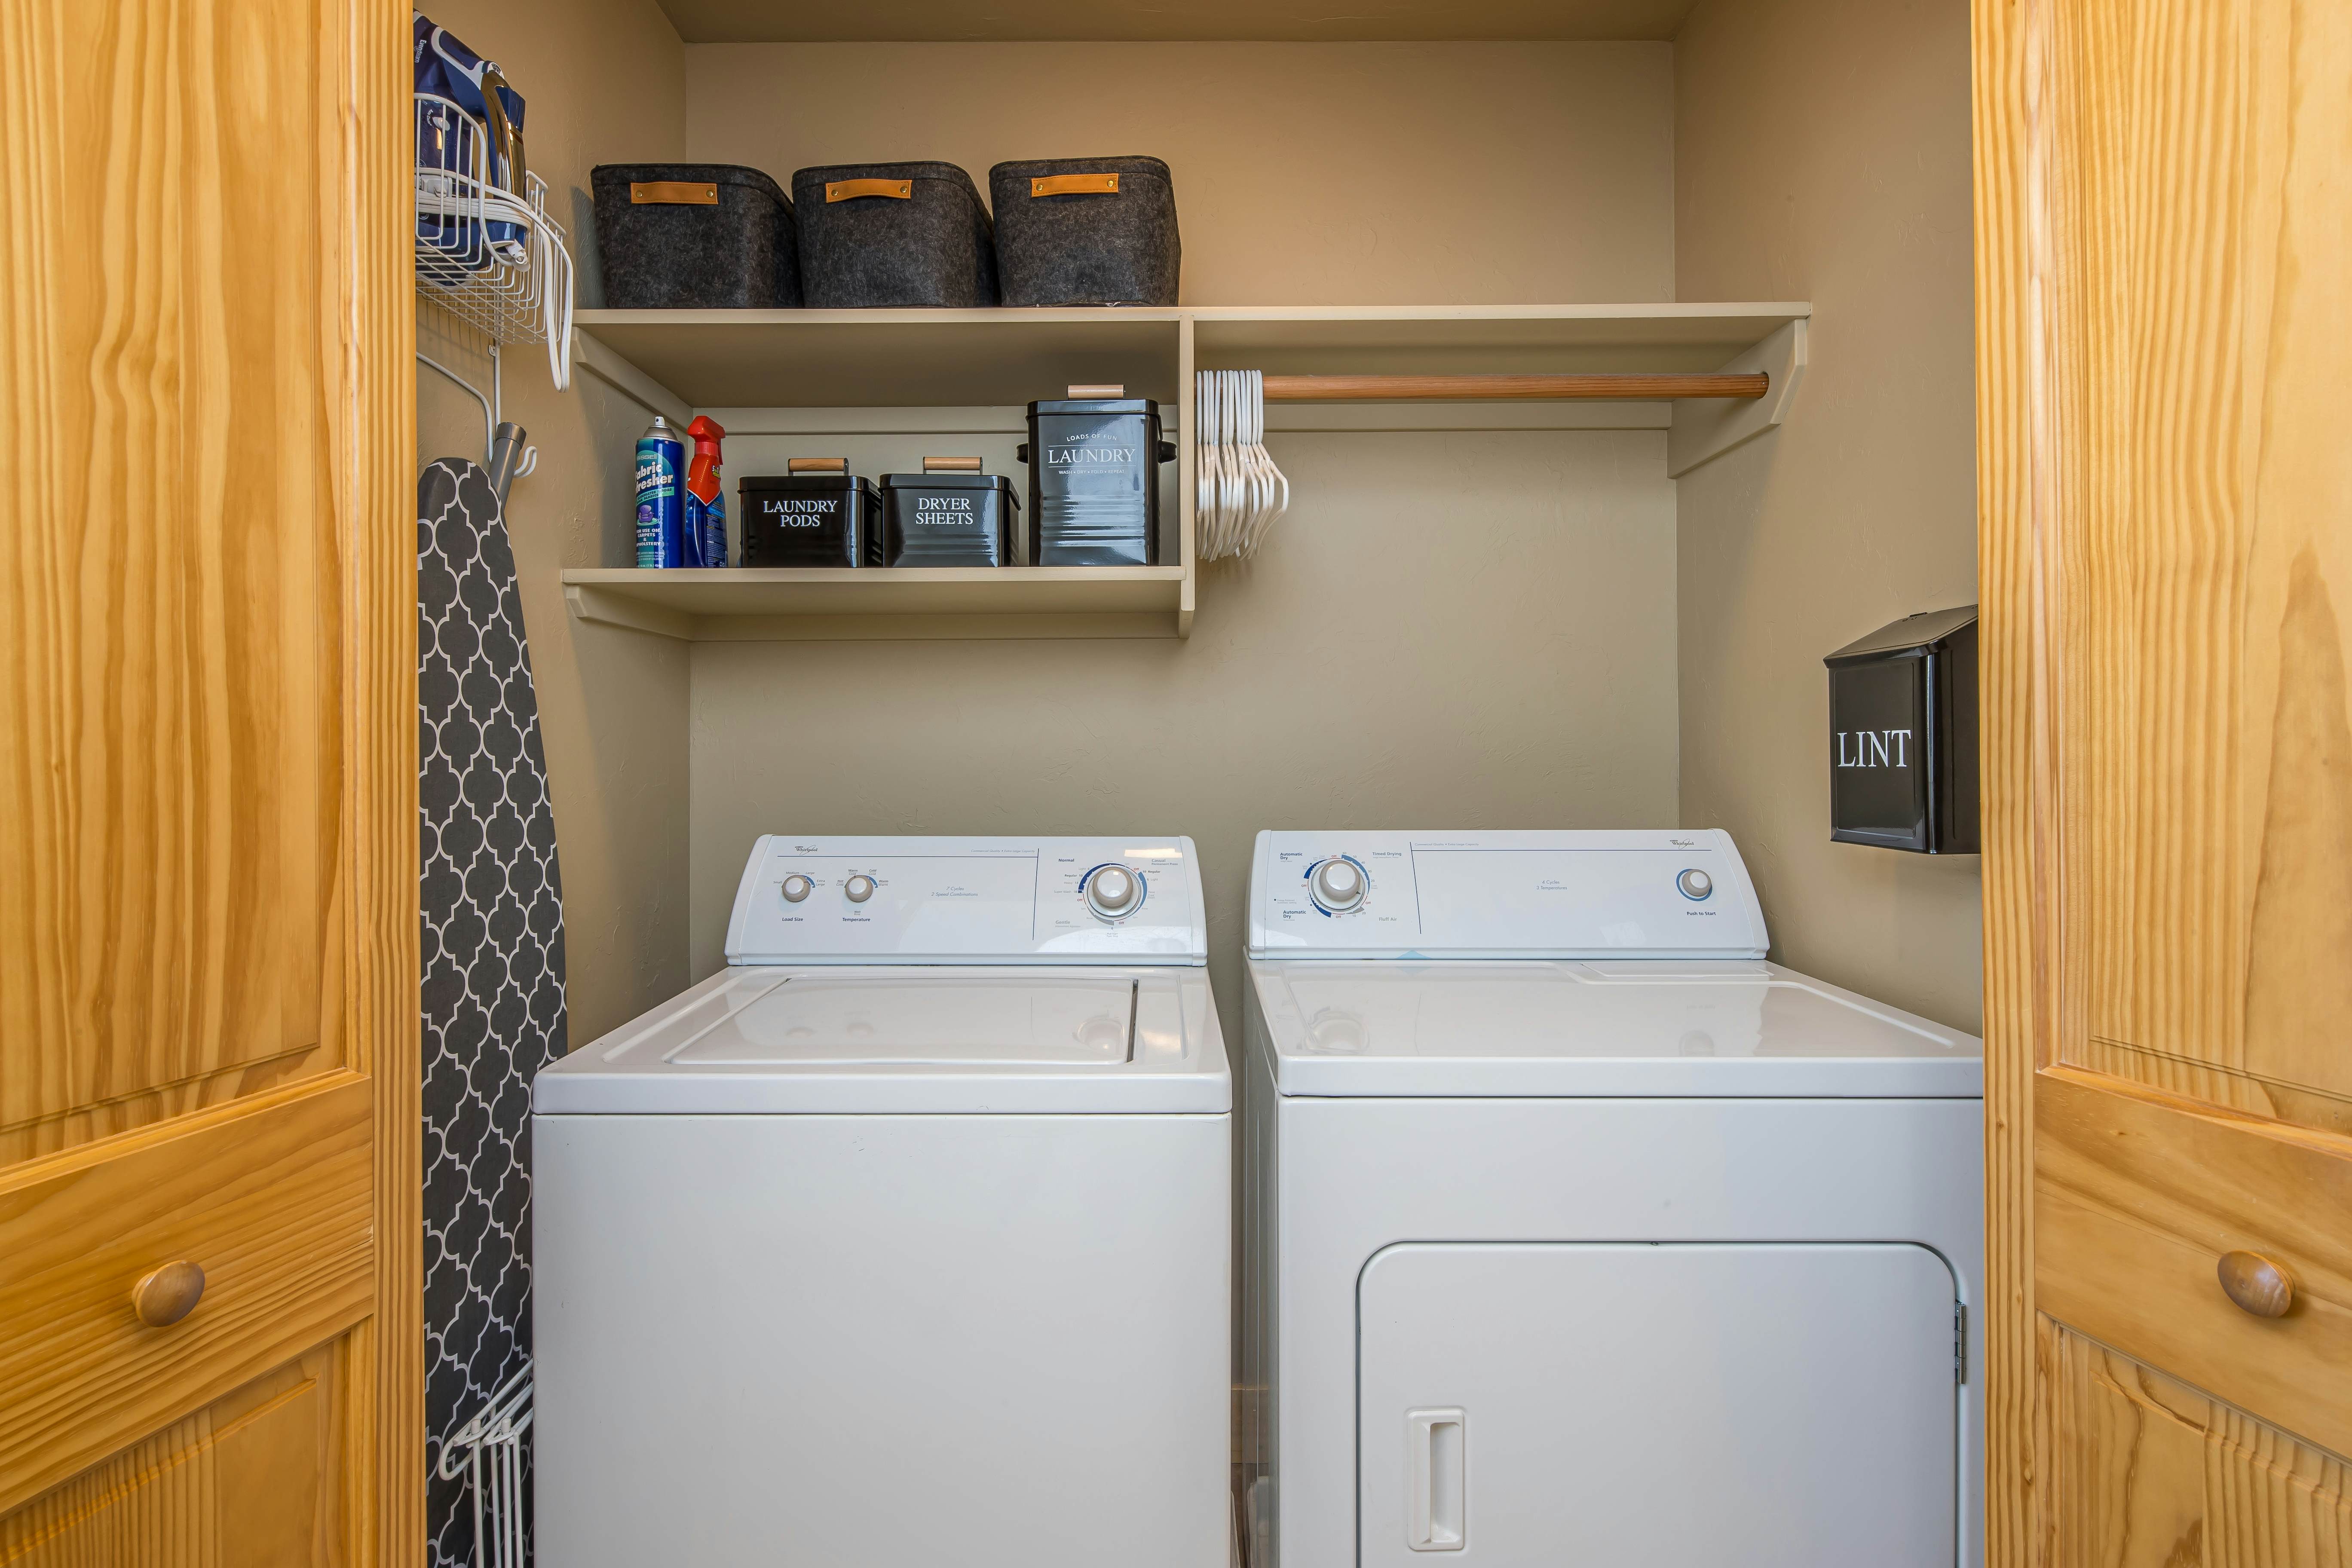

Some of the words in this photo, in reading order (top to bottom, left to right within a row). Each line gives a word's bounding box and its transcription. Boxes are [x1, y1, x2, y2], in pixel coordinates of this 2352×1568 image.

[1048, 449, 1136, 464] LAUNDRY
[763, 500, 838, 512] LAUNDRY
[918, 498, 971, 510] DRYER
[781, 515, 820, 527] PODS
[916, 512, 973, 524] SHEETS
[1837, 729, 1911, 767] LINT
